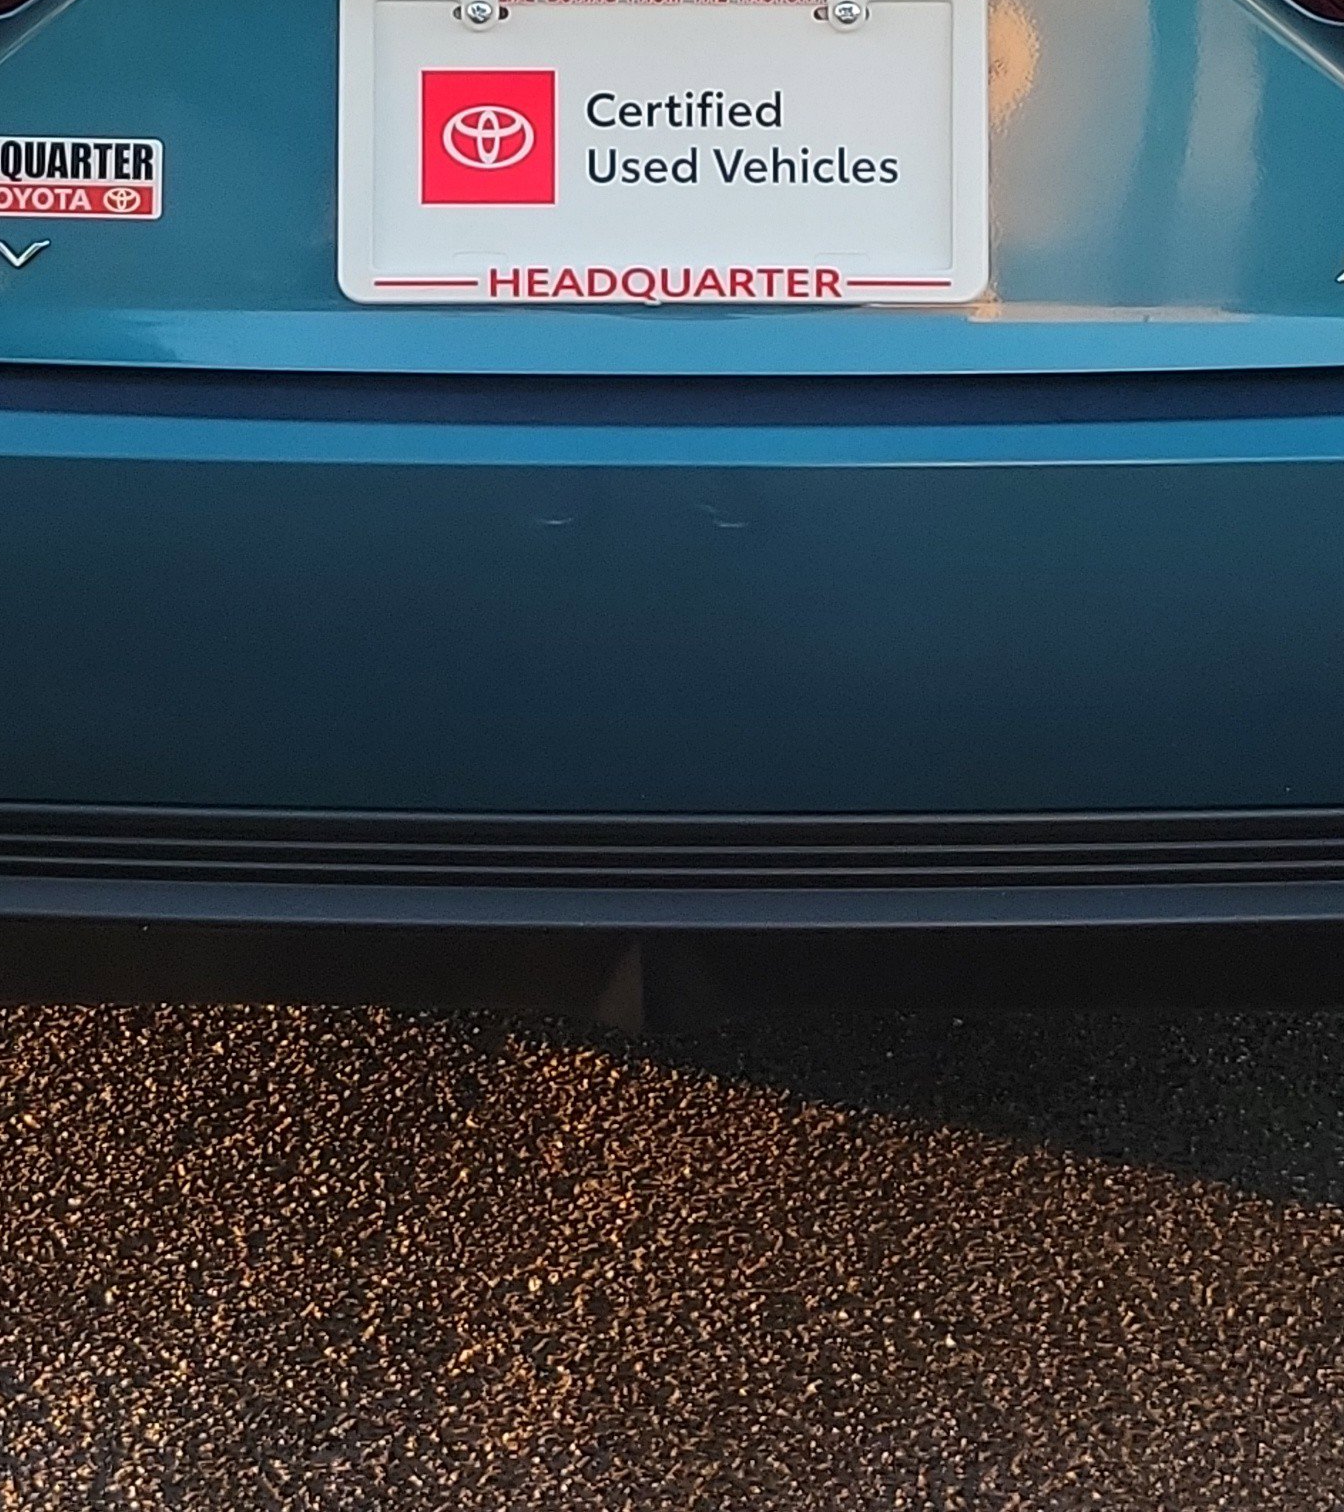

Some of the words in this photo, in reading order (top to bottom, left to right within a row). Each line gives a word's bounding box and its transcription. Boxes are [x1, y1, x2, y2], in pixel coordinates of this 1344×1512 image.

[586, 91, 782, 128] Certified
[588, 147, 698, 184] Used
[713, 147, 899, 184] Vehicles
[489, 268, 843, 301] HEADQUARTER
